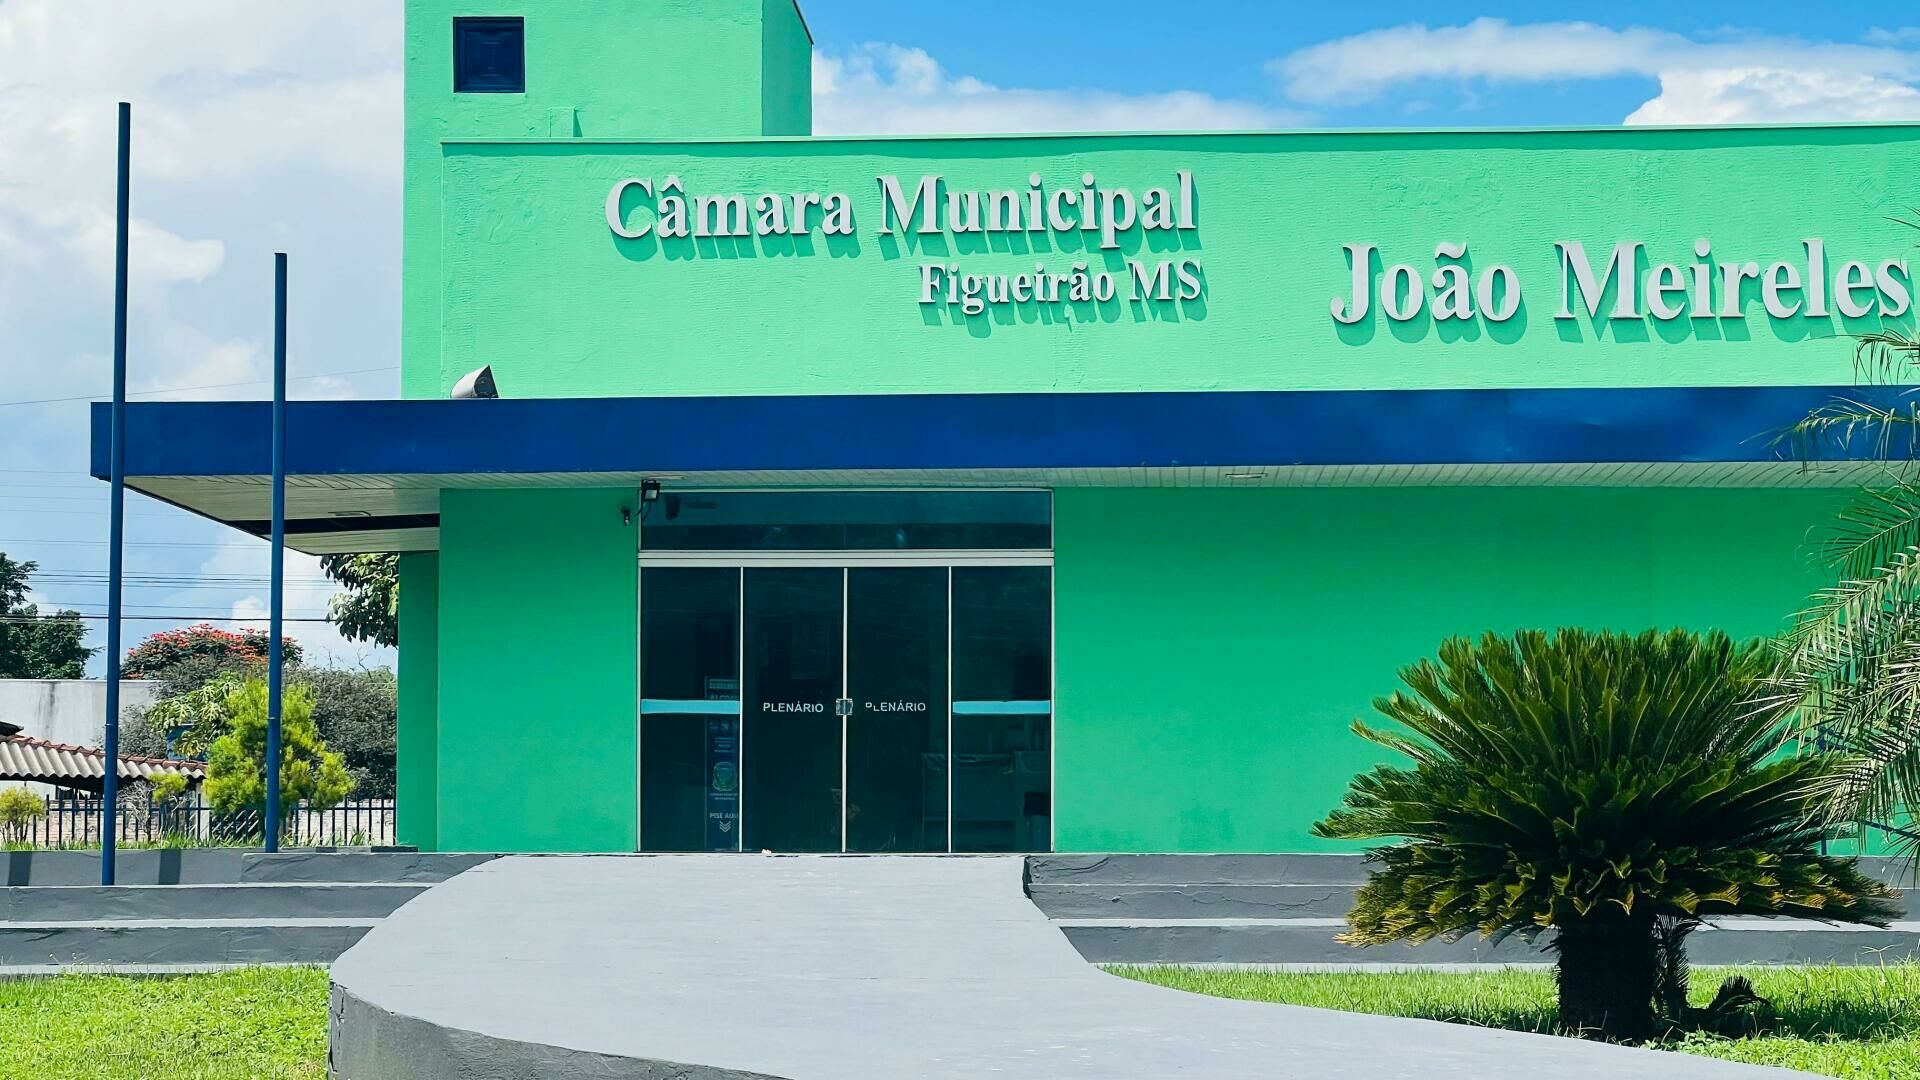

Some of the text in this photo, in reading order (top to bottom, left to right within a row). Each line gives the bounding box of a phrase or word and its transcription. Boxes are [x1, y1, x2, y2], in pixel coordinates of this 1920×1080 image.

[605, 170, 1197, 248] Câmara Municipal
[918, 259, 1202, 315] Figueirão MS
[1330, 237, 1910, 324] João Meireles
[762, 701, 824, 713] PLENÁRIO
